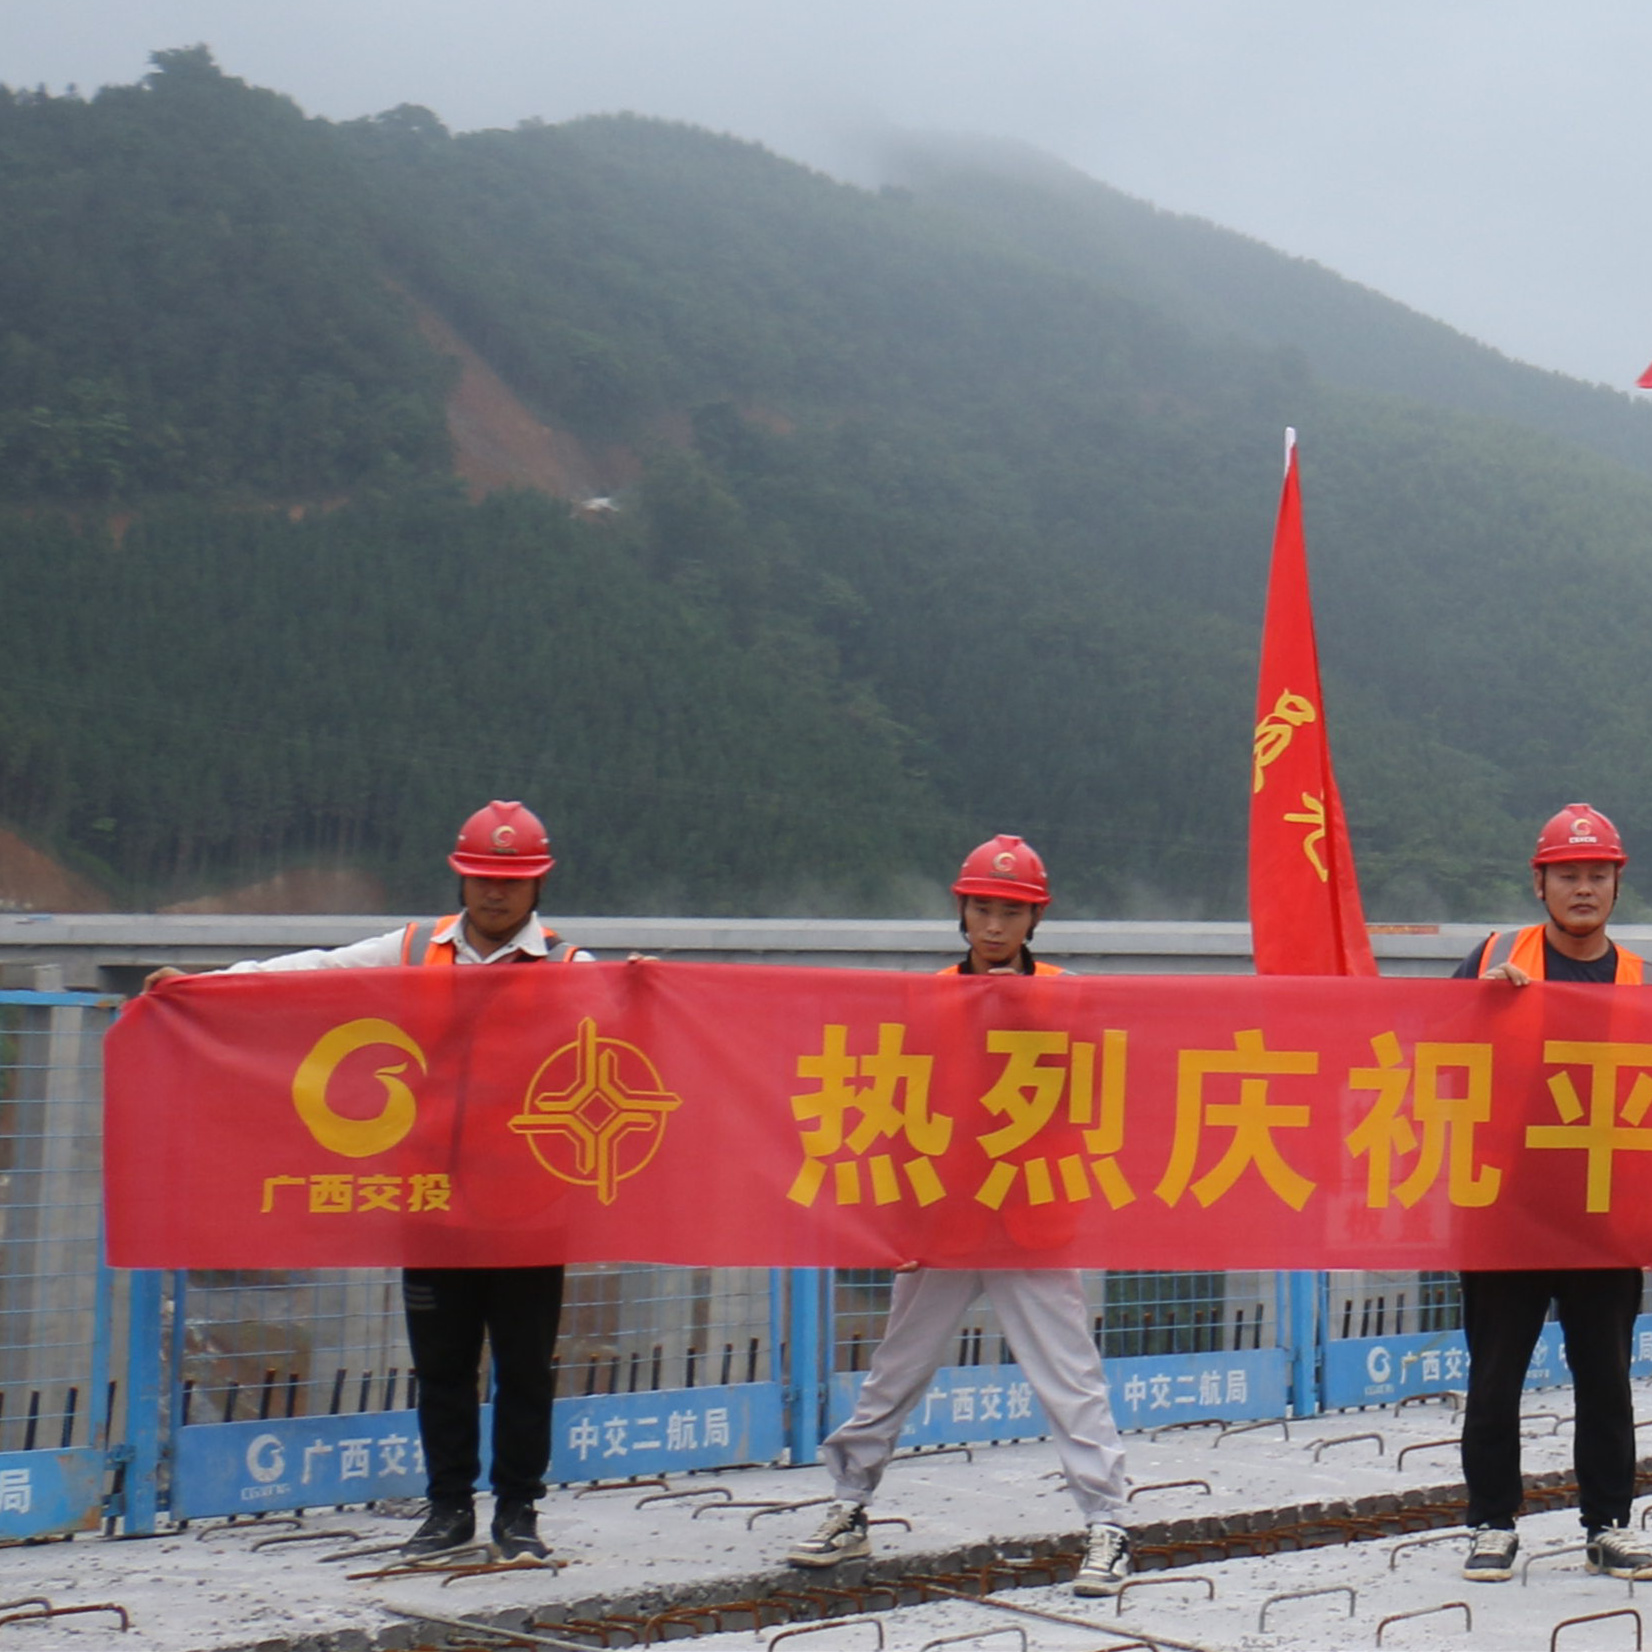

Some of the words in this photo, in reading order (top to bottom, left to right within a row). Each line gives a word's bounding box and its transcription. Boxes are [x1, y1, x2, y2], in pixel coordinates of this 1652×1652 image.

[261, 1174, 451, 1213] 广西交投
[1400, 1347, 1471, 1385] 广西交
[922, 1381, 1034, 1426] 广西交投
[1123, 1369, 1247, 1413] 中交二航局
[569, 1407, 730, 1462] 中交二航局
